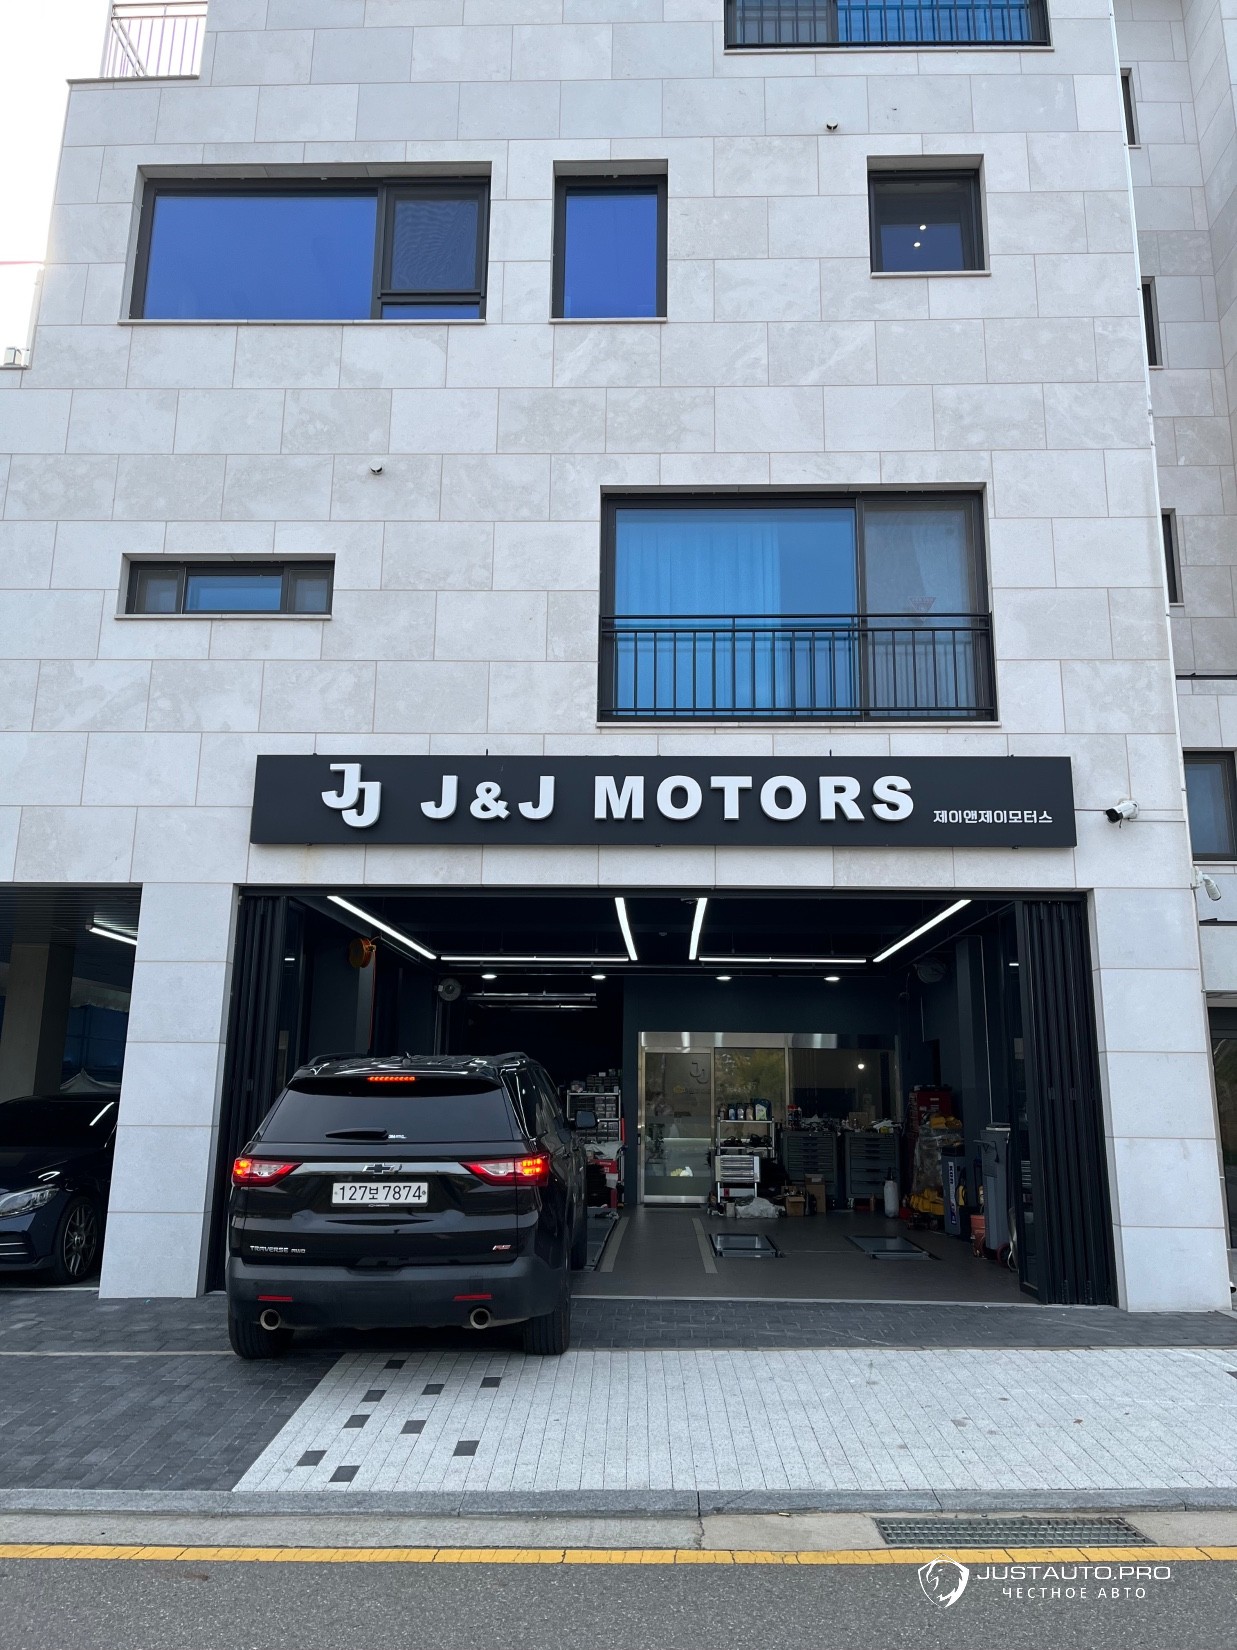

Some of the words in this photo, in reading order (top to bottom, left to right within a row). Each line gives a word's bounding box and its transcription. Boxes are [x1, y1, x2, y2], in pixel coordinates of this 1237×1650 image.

[420, 774, 556, 820] J&J
[594, 774, 915, 821] MOTORS
[933, 809, 1053, 824] 제이앤제이모터스
[249, 1245, 289, 1253] TRAVERSE
